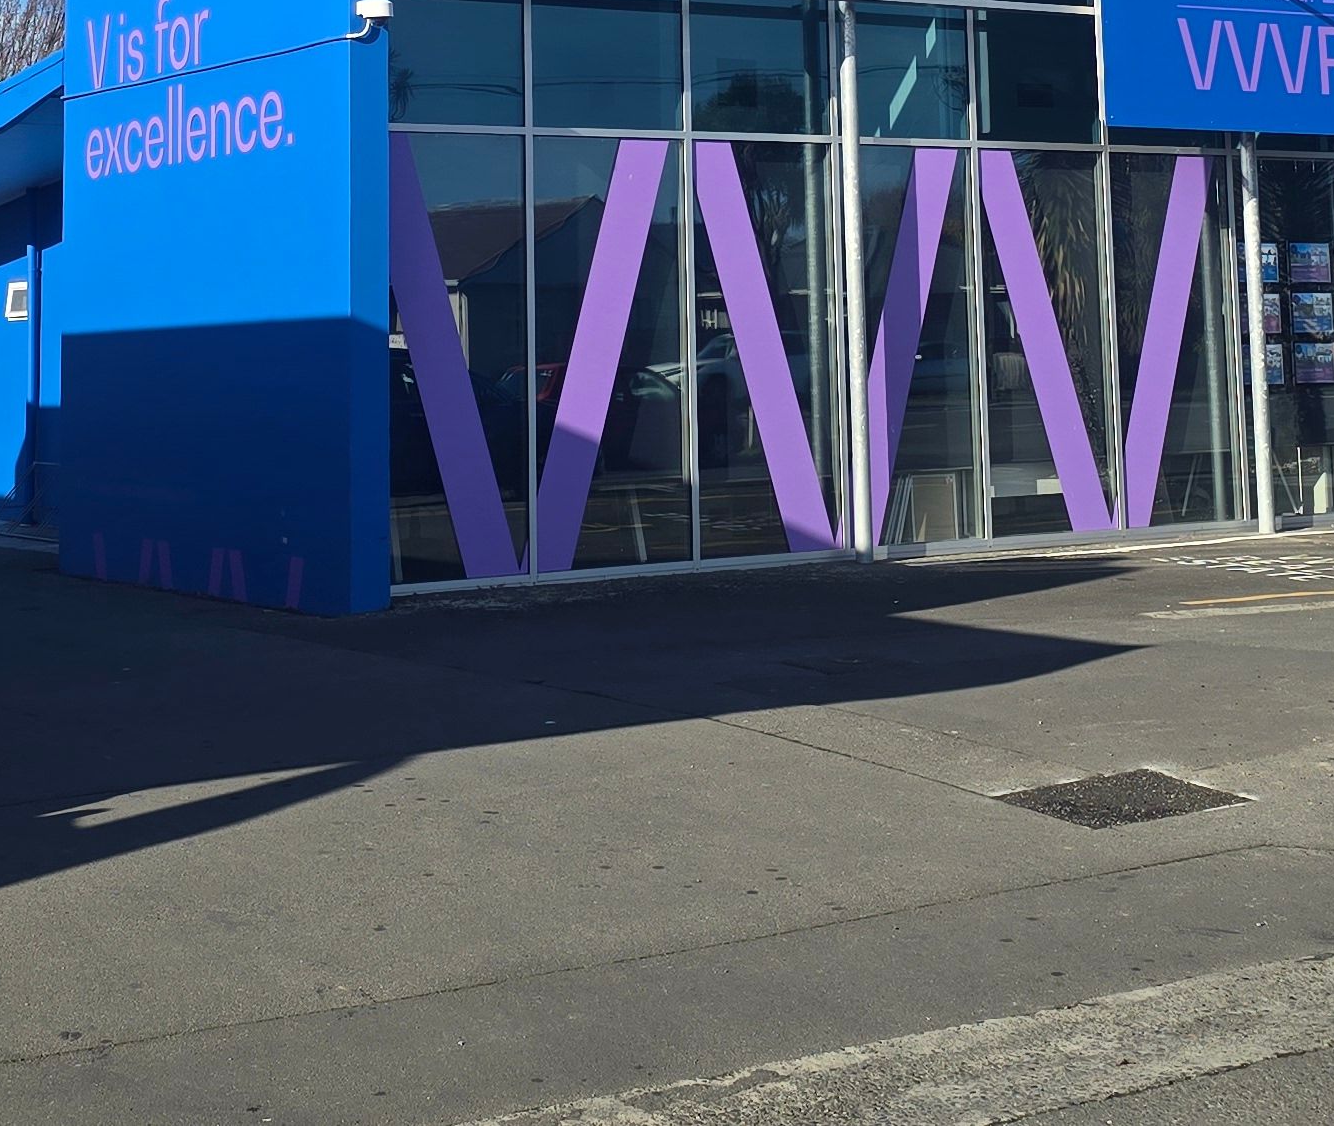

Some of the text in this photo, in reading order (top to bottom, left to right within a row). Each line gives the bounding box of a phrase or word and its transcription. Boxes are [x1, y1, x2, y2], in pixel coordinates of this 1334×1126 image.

[86, 14, 112, 90] V
[118, 13, 145, 84] is
[85, 83, 295, 180] excellence.
